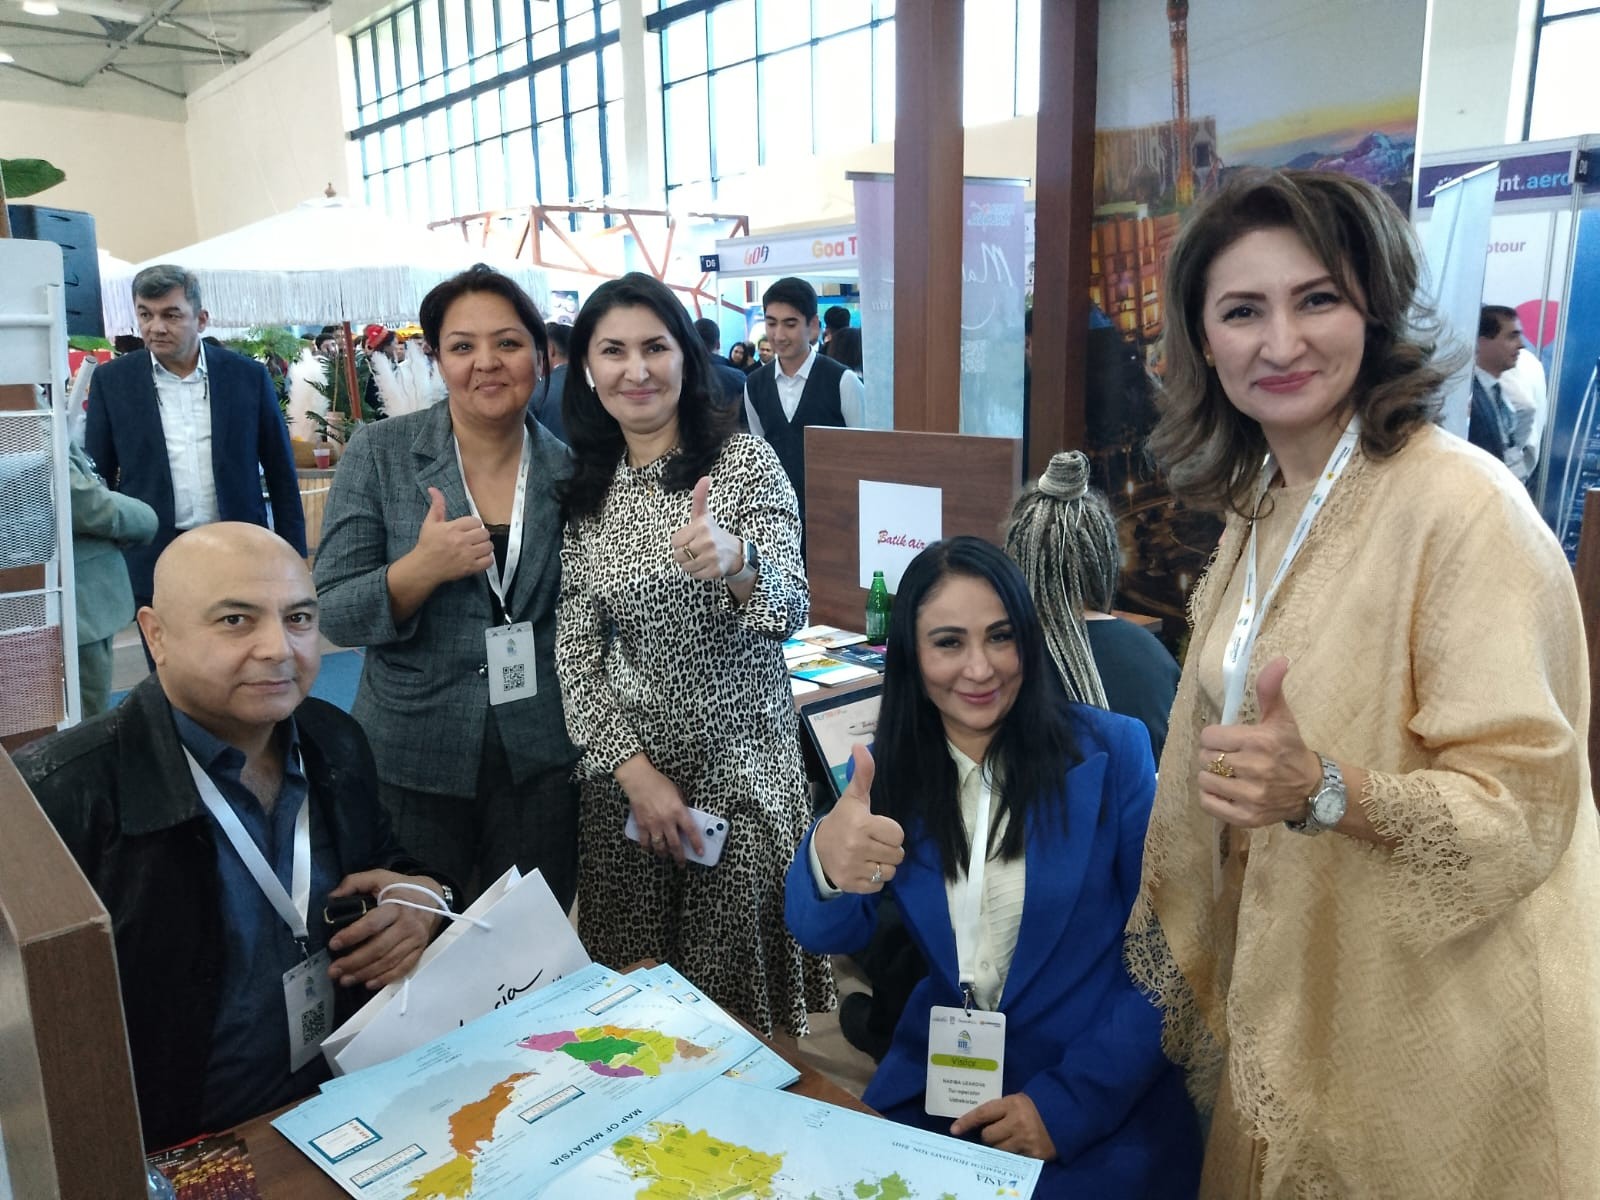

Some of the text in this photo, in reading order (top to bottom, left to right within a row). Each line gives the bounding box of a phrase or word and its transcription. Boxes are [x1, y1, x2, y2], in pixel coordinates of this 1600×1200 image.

[1496, 172, 1570, 192] nt.aero
[812, 236, 858, 259] Goa T
[1487, 240, 1527, 254] otour
[877, 530, 907, 547] Batik
[550, 1108, 643, 1166] MAP OF MALAYSIA
[976, 1173, 1007, 1187] ASIA
